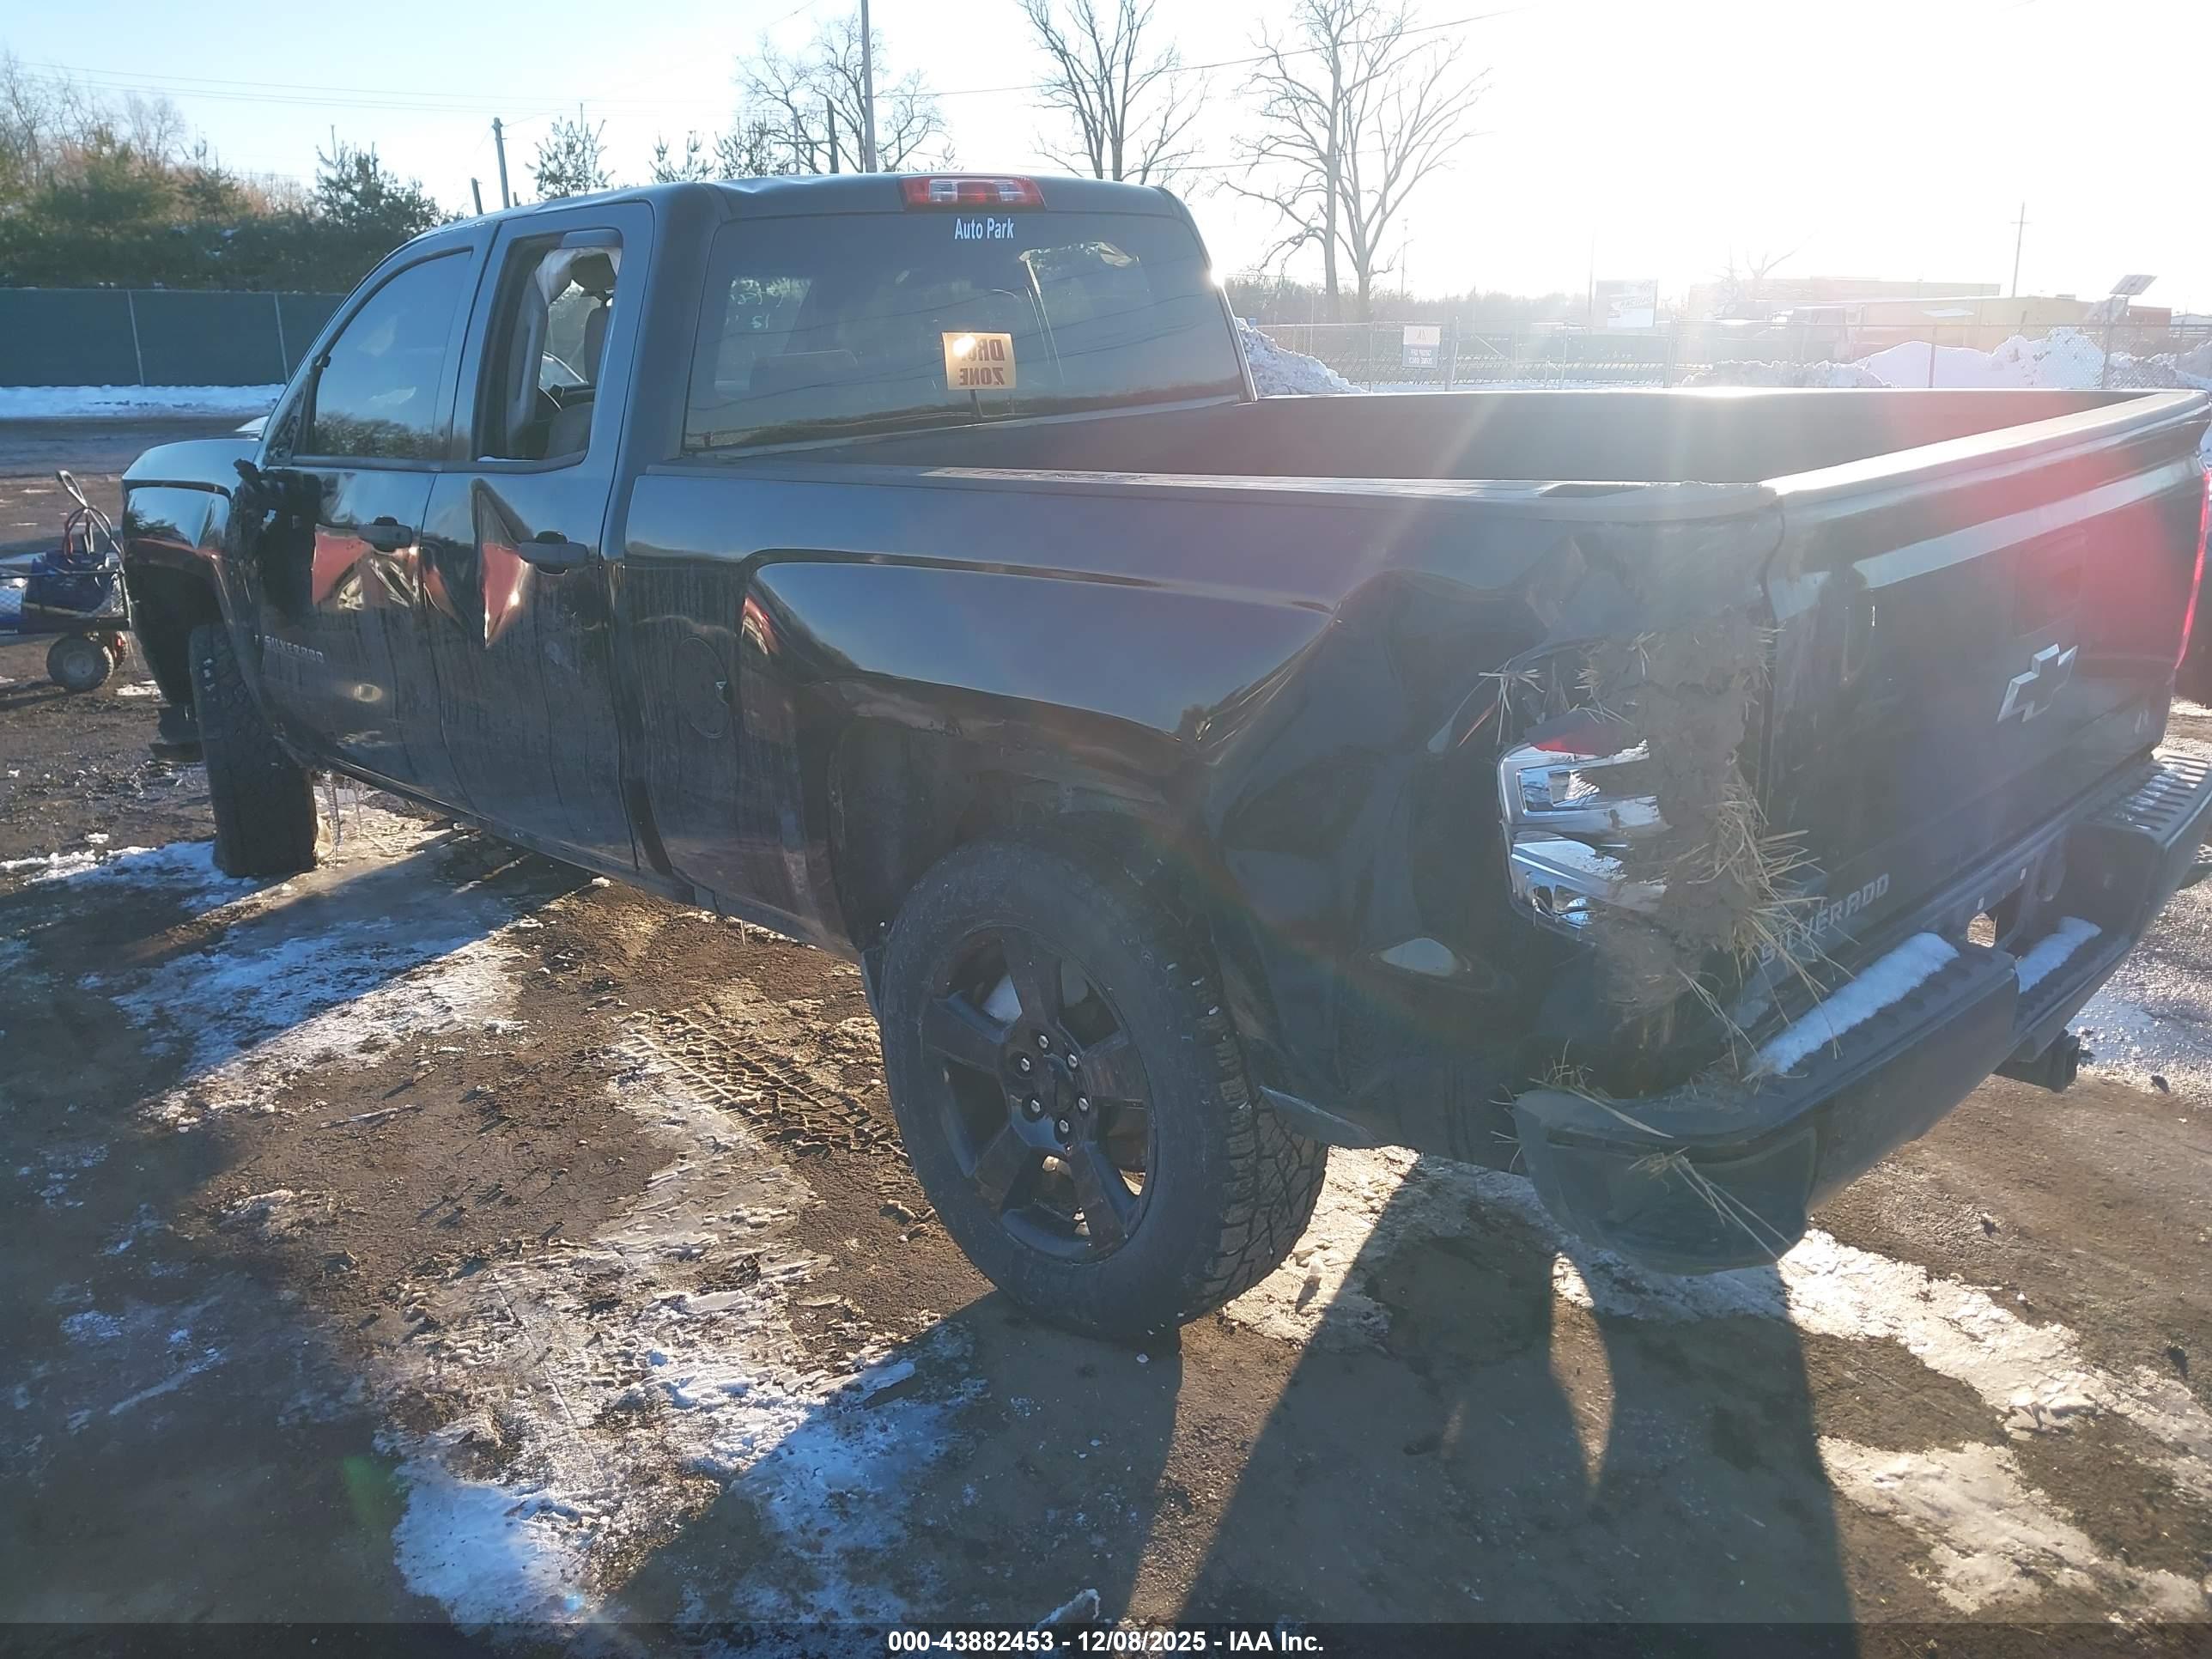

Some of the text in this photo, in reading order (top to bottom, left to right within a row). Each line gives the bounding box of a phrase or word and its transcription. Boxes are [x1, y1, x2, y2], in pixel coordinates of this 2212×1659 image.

[955, 217, 1014, 240] Auto Park
[264, 635, 324, 663] SILVERADO
